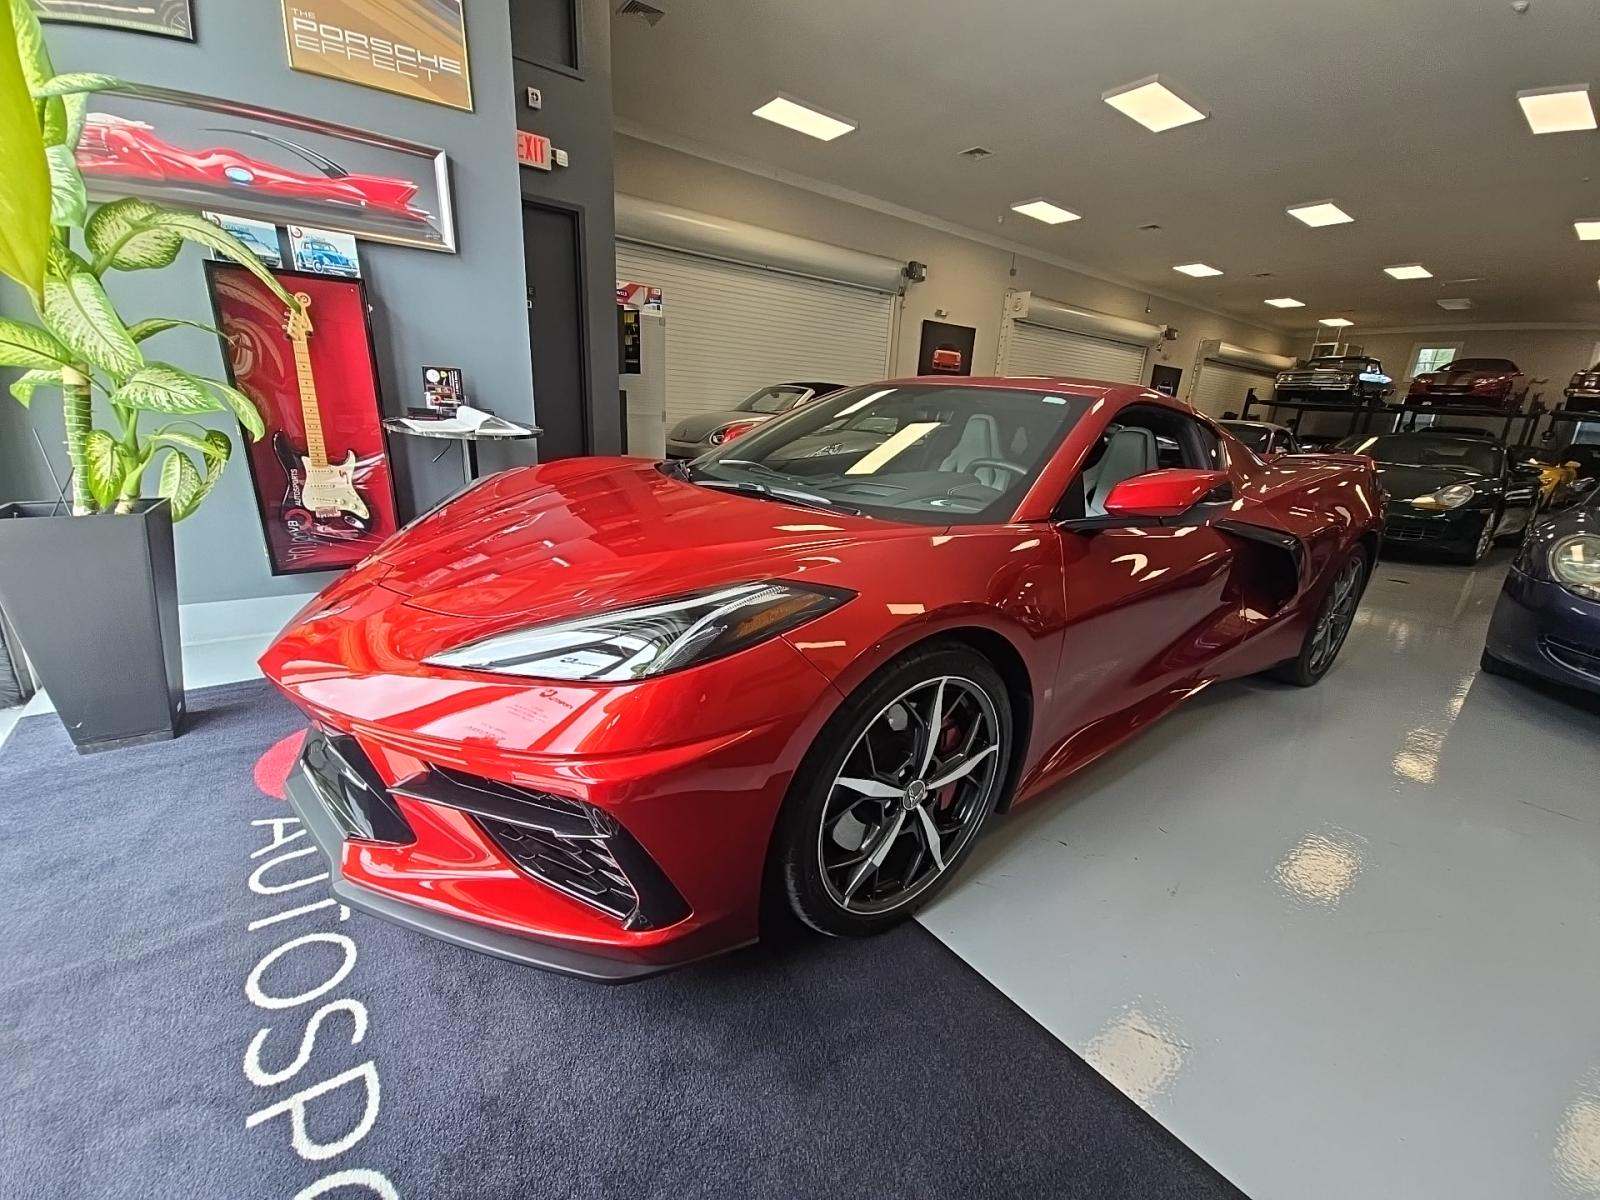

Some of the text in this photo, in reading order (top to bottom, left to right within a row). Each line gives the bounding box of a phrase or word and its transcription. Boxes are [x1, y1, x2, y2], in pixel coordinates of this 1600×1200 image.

[292, 8, 316, 19] THE
[293, 17, 461, 75] PORSCHE
[295, 34, 439, 82] EFFECT
[518, 134, 545, 164] EXIT
[290, 468, 302, 506] AUTOSPORTS
